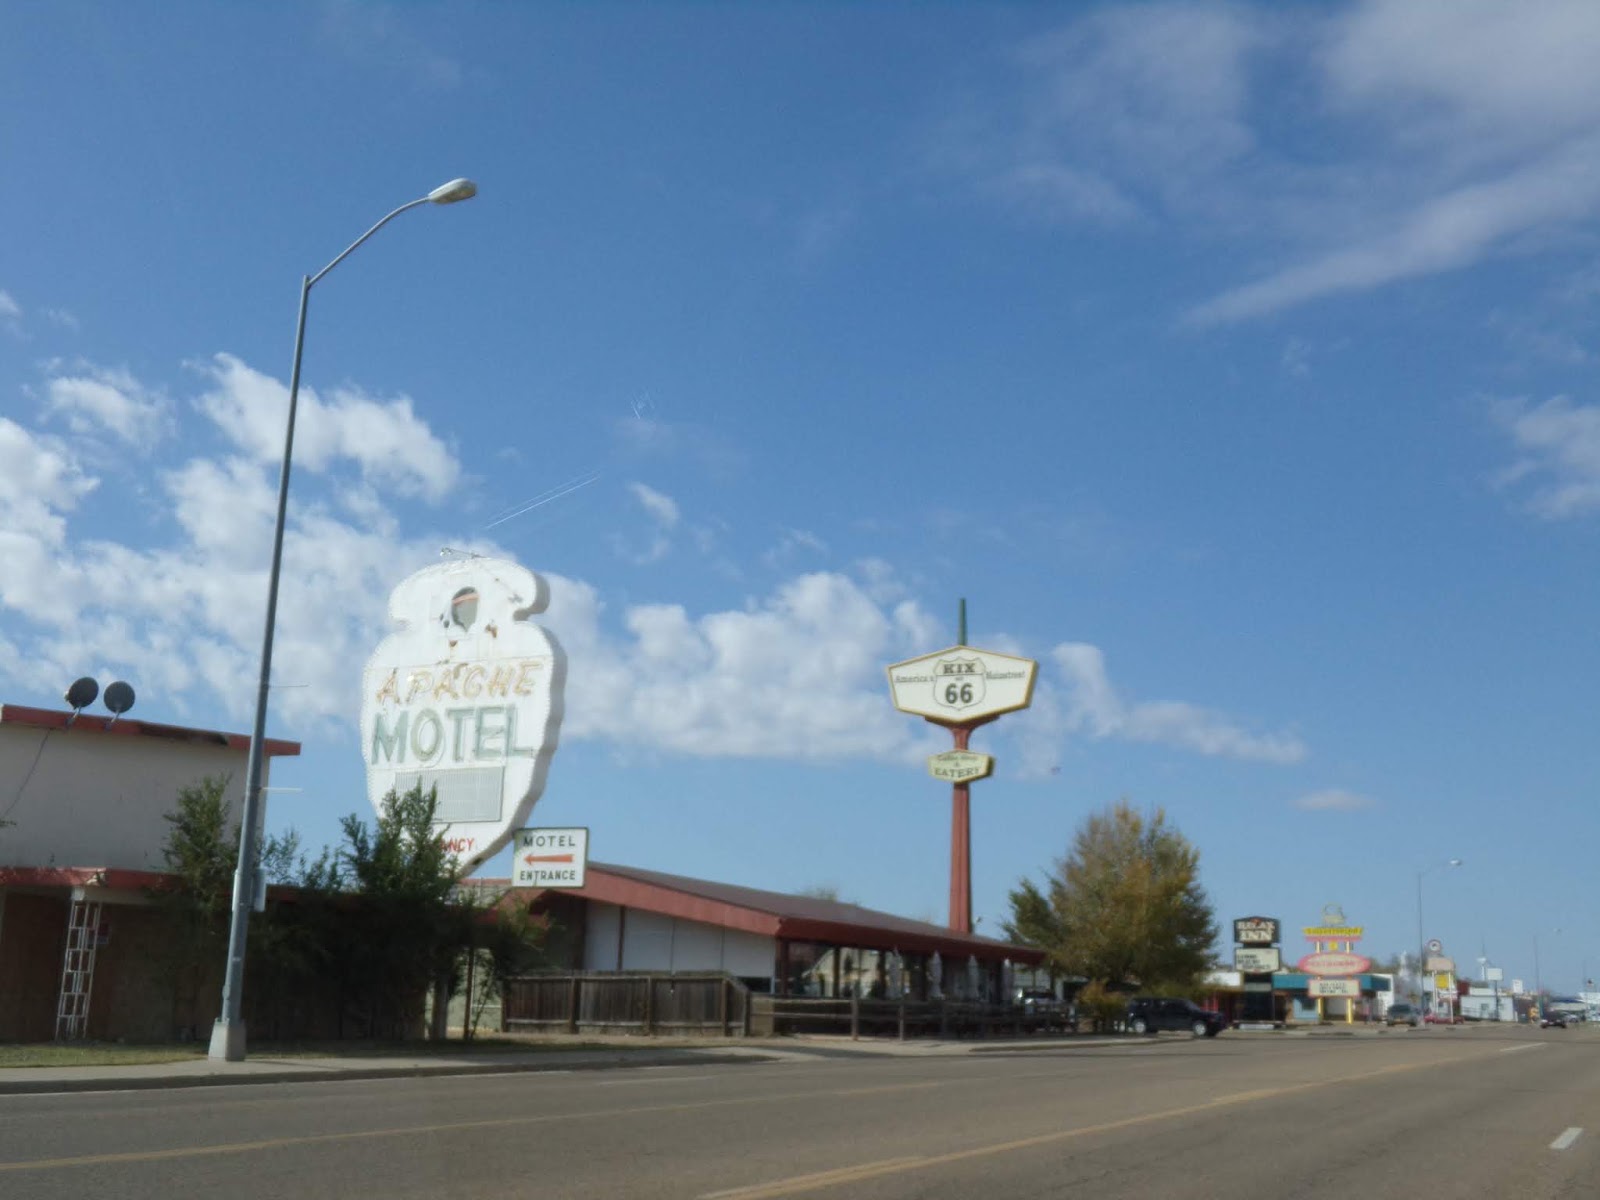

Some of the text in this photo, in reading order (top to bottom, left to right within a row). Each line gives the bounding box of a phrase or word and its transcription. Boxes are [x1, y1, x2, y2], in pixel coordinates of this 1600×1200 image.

[943, 662, 976, 674] KIX
[375, 661, 542, 705] APACHE
[945, 682, 974, 705] 66
[371, 704, 536, 766] MOTEL
[523, 835, 576, 847] MOTEL
[520, 870, 576, 881] ENTRANCE
[1239, 930, 1273, 941] INN
